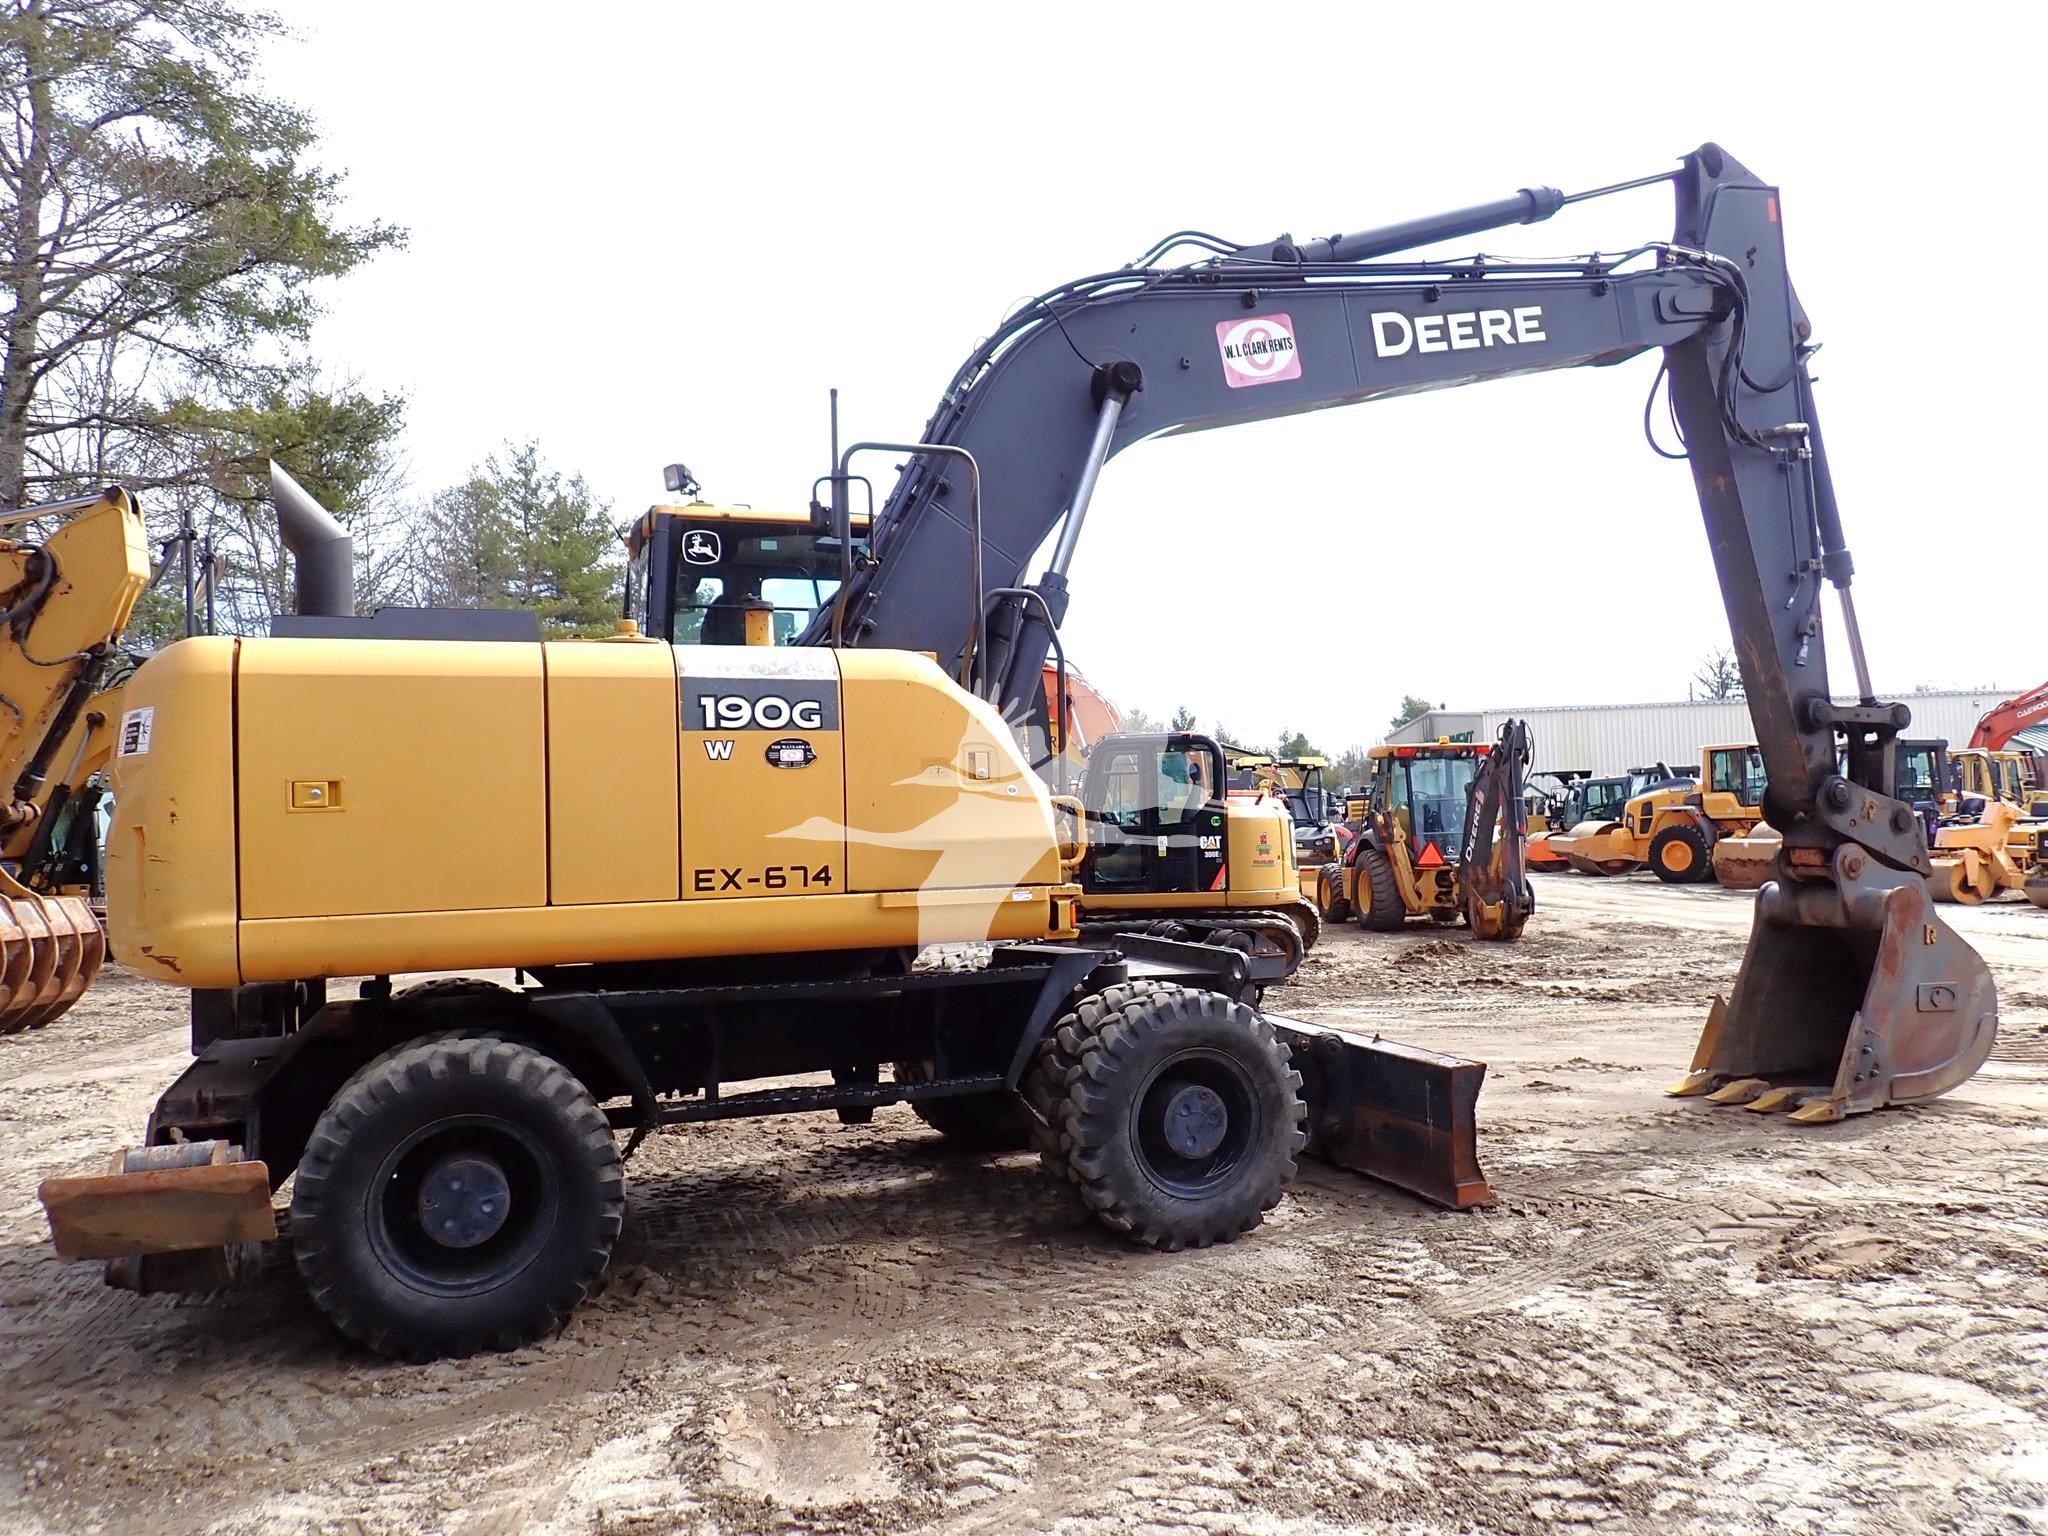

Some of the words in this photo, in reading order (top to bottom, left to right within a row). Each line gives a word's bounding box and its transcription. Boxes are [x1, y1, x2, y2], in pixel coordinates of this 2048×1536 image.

[1370, 306, 1547, 358] DEERE
[1242, 339, 1269, 356] CLARK
[1268, 336, 1294, 352] RENTS
[698, 695, 823, 730] 190G
[2017, 700, 2048, 718] DAEWOO
[703, 740, 734, 760] W
[1200, 836, 1222, 849] CAT
[1465, 800, 1481, 862] DEERE
[695, 864, 832, 892] EX-674
